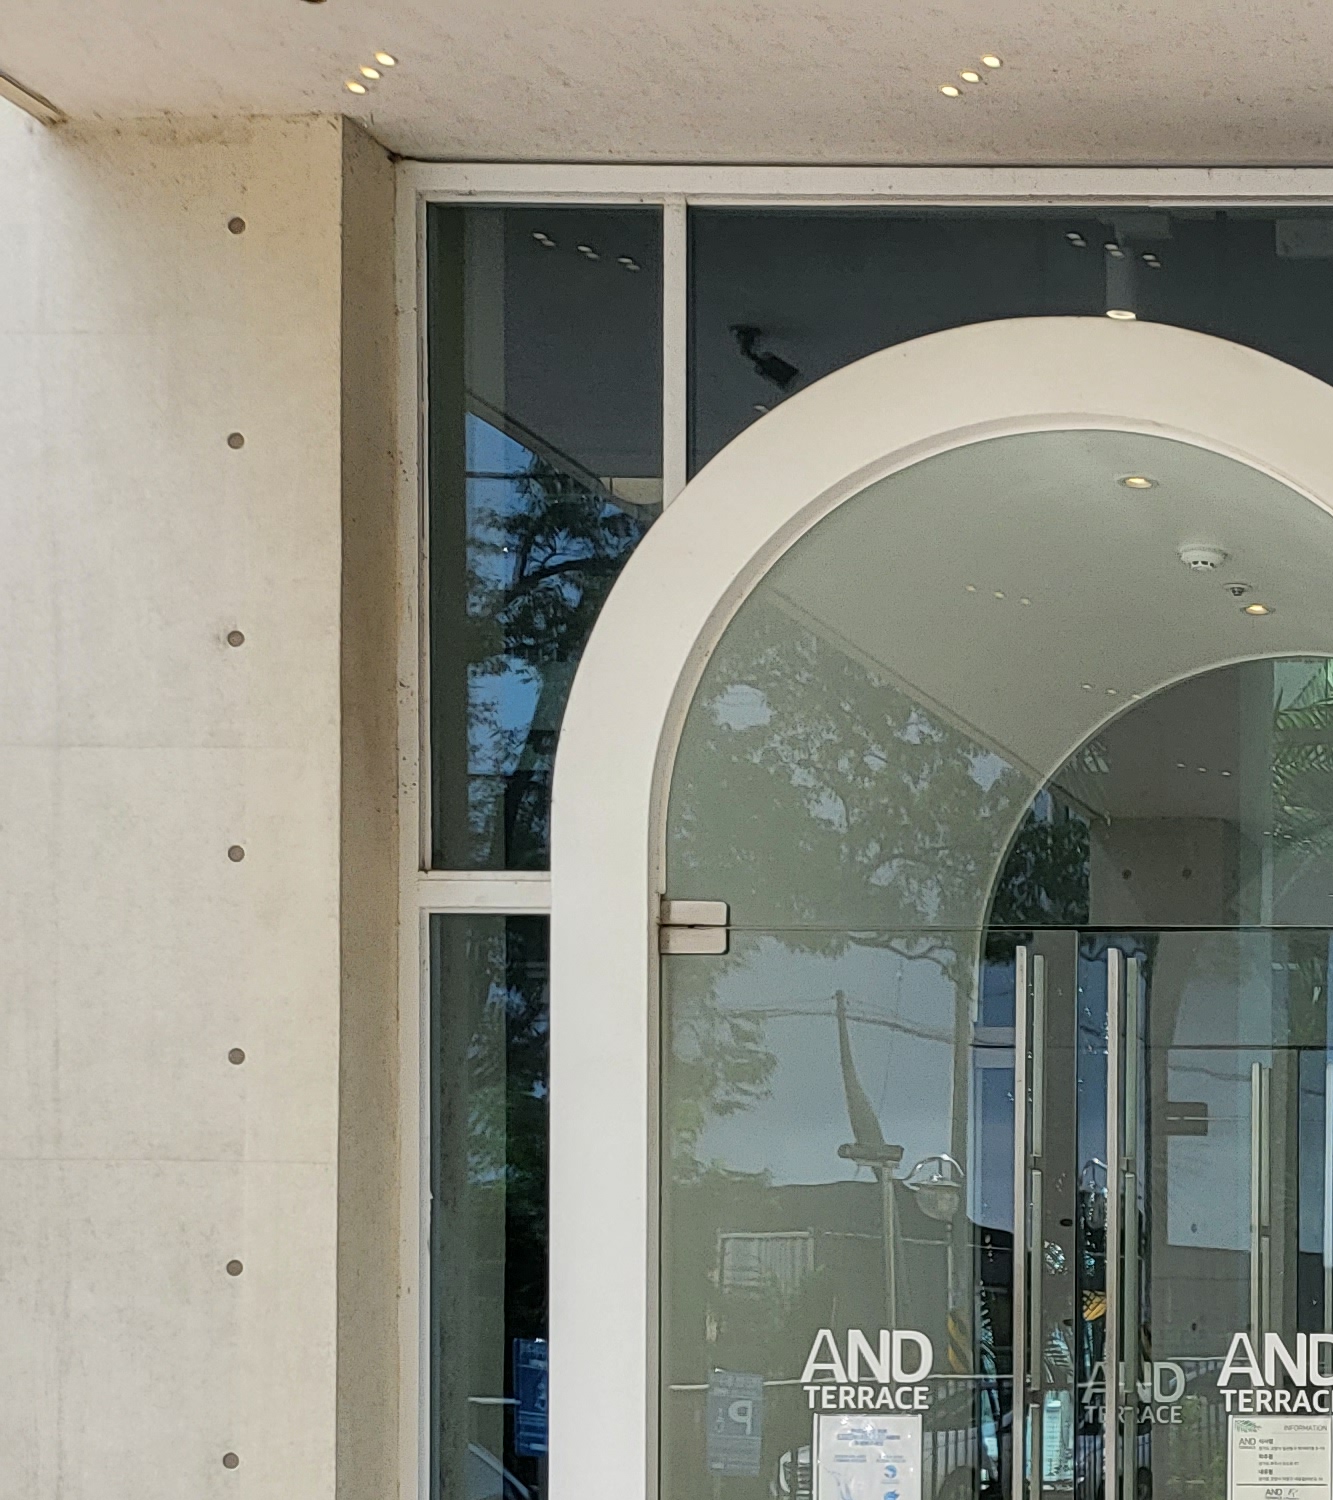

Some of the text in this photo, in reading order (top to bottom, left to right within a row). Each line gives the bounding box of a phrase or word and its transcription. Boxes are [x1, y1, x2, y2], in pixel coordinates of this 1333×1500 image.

[800, 1329, 933, 1383] AND
[803, 1386, 930, 1410] TERRACE
[1238, 1437, 1257, 1446] AND
[1265, 1488, 1283, 1496] AND
